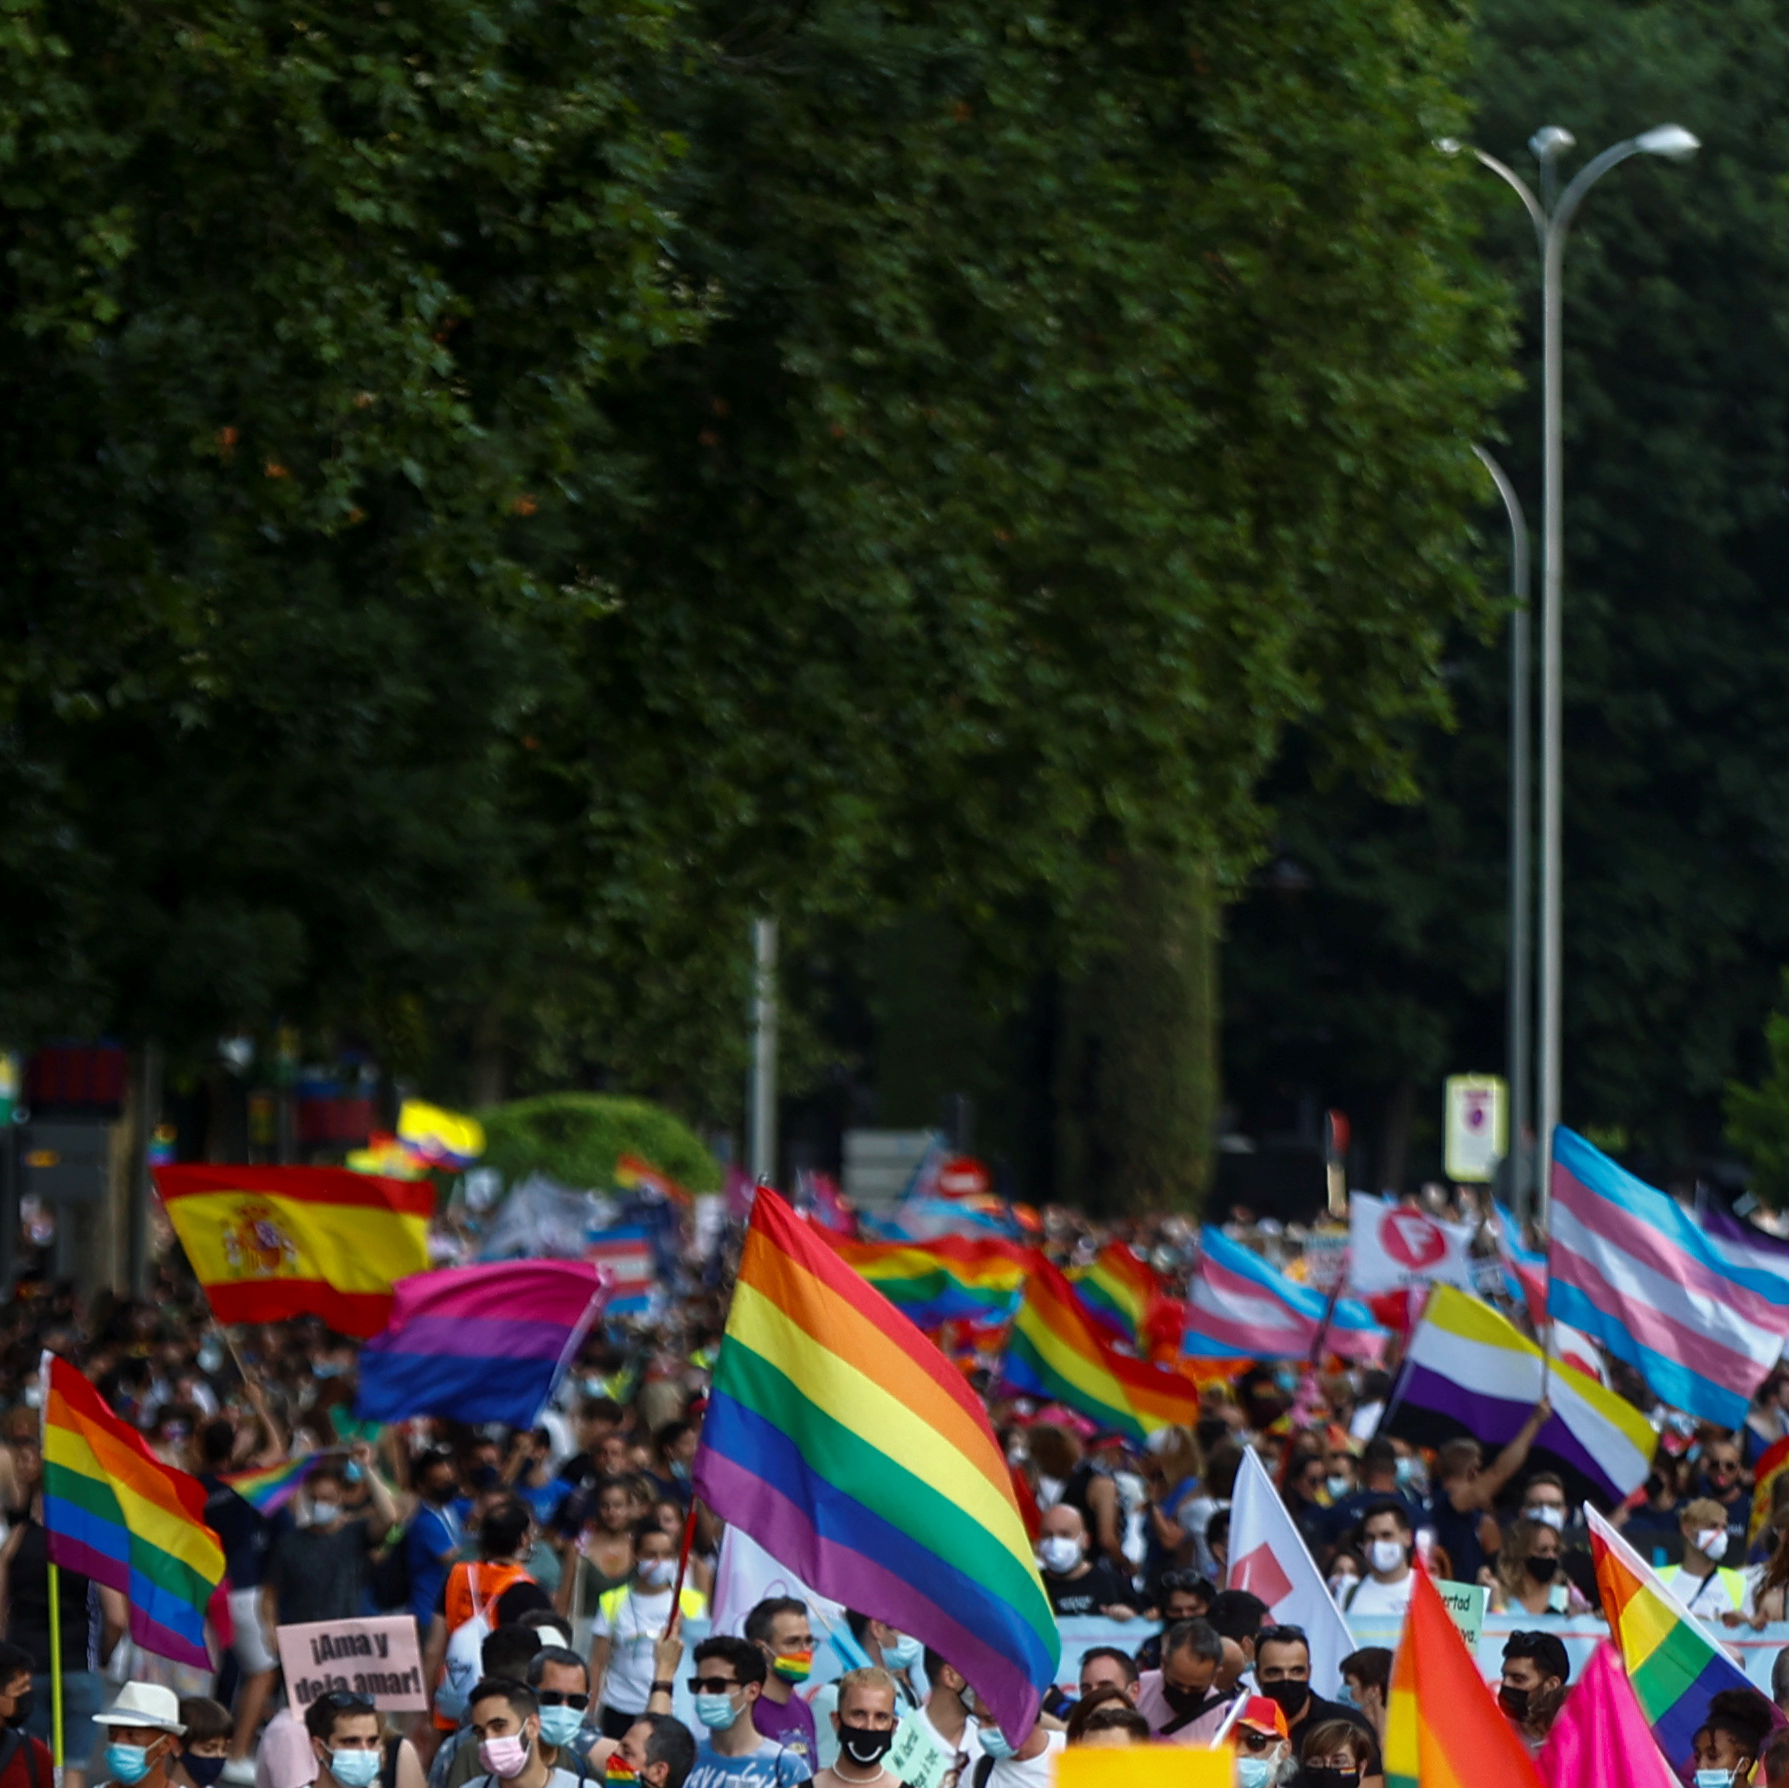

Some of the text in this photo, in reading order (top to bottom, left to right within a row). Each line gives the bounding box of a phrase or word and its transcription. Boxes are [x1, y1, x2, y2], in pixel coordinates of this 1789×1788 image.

[311, 1632, 389, 1665] ¡Ama y
[352, 1665, 421, 1696] amar!
